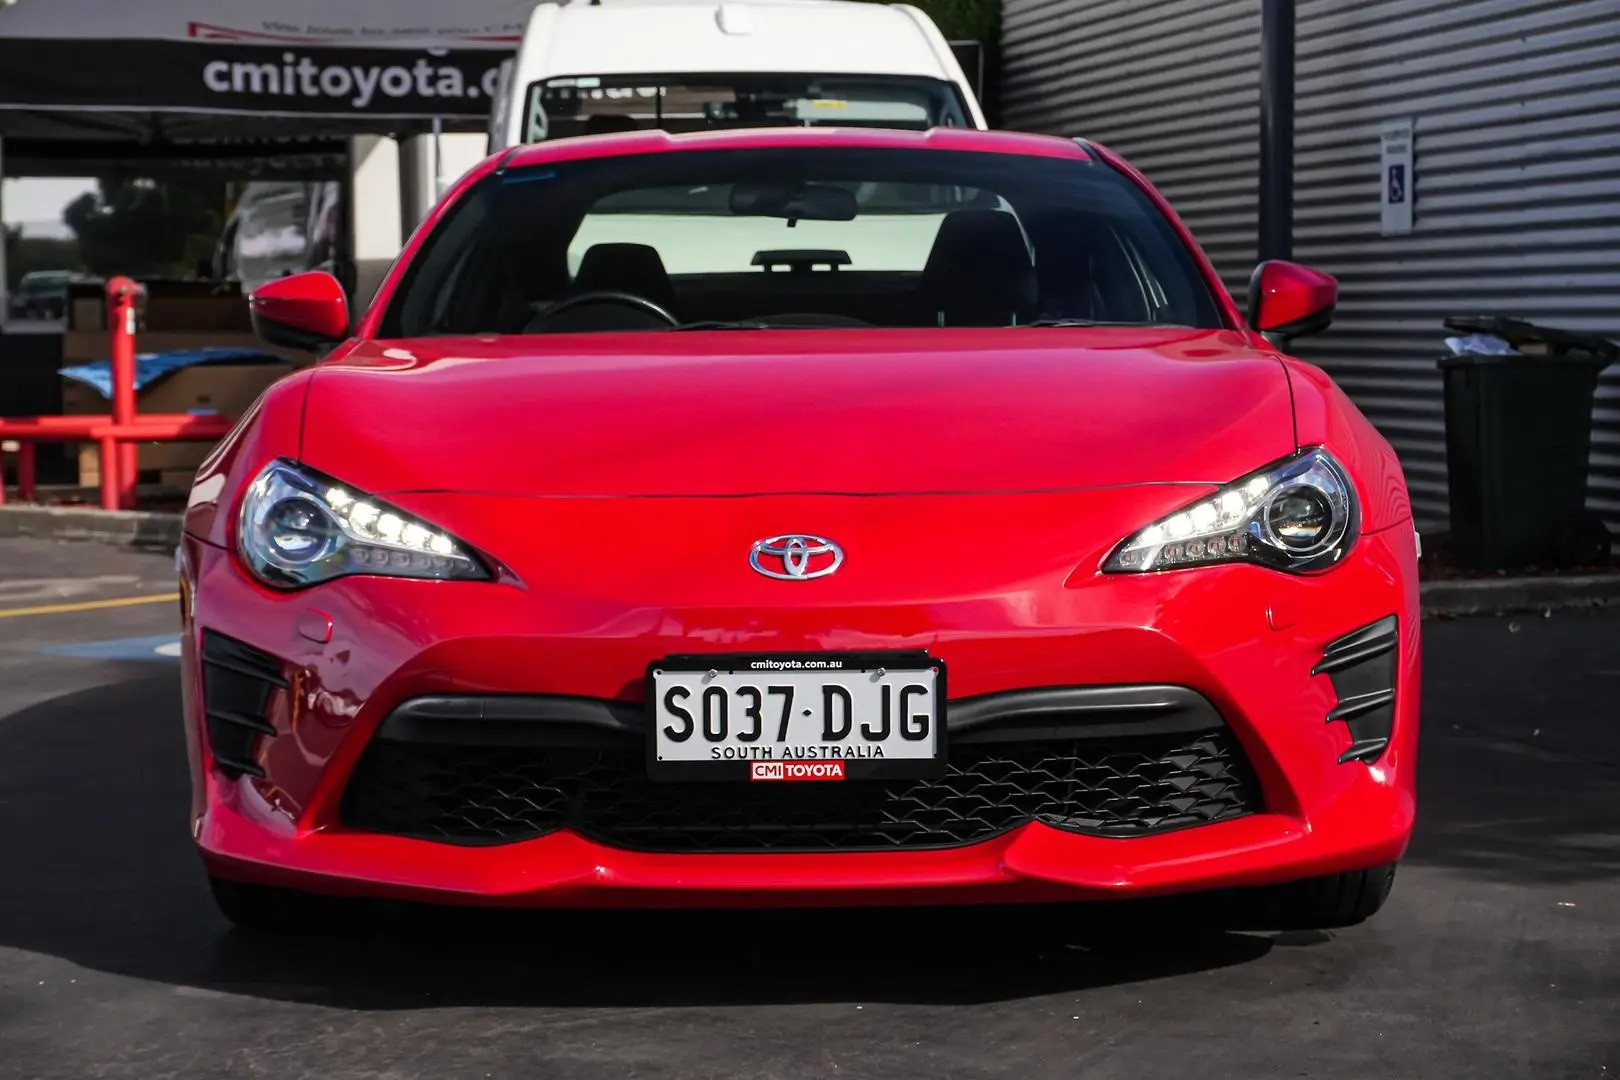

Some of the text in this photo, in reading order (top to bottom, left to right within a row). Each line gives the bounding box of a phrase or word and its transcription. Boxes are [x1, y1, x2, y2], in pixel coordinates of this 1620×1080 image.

[750, 660, 843, 671] cmitoyota.com.au
[711, 745, 885, 760] SOUTH AUSTRALIA
[754, 764, 843, 777] CMI TOYOTA
